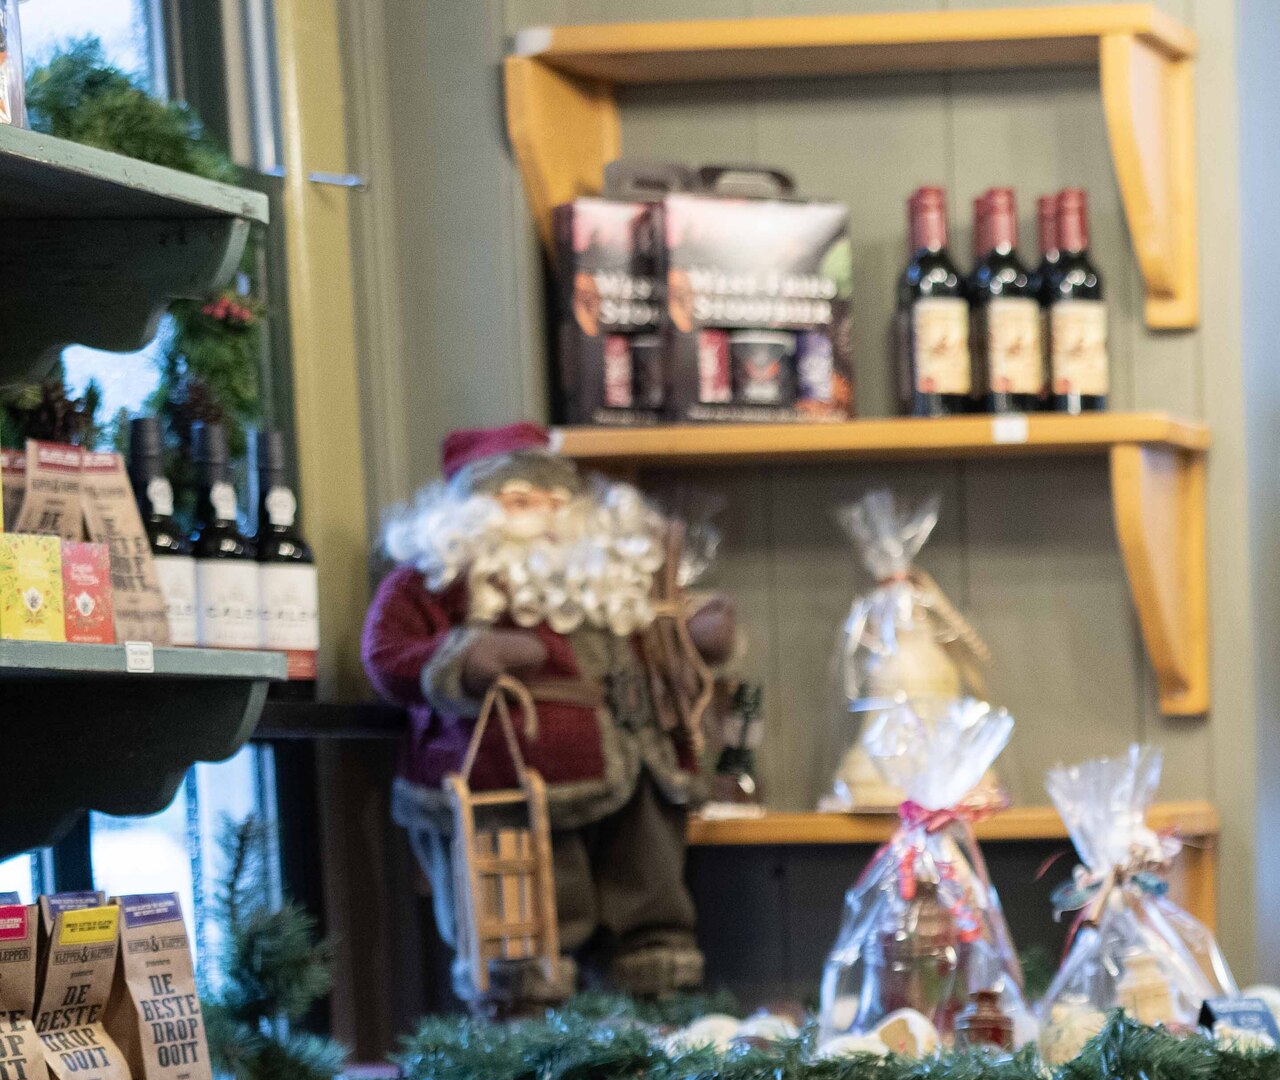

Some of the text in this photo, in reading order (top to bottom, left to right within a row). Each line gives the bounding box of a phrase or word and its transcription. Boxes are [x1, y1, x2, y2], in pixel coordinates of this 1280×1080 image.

[61, 984, 91, 1006] DE
[149, 974, 174, 997] DE
[37, 1004, 101, 1033] BESTE
[140, 994, 200, 1022] BESTE
[39, 1027, 100, 1052] DROP
[151, 1017, 198, 1044] DROP
[60, 1046, 110, 1072] OOIT
[157, 1040, 199, 1068] OOIT
